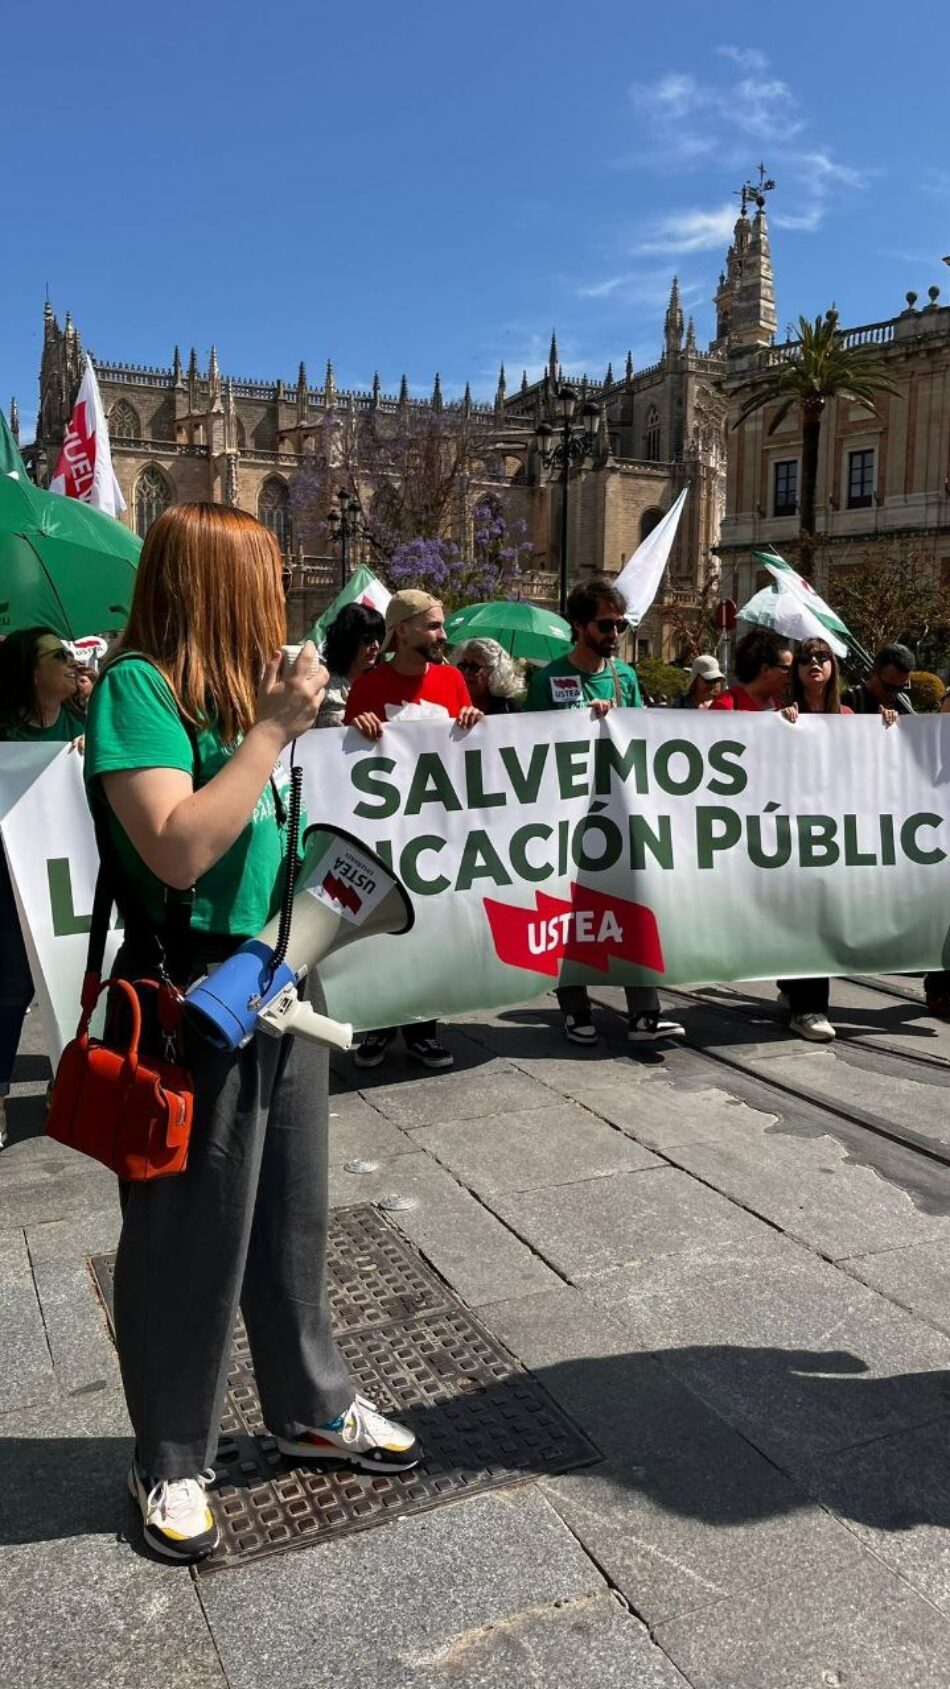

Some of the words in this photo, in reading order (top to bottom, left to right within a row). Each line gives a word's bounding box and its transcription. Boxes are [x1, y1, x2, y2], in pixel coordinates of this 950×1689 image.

[350, 738, 748, 819] SALVEMOS
[46, 857, 124, 937] L
[695, 801, 948, 869] PÚBLIC
[333, 857, 376, 894] USTEA
[527, 910, 624, 955] USTEA
